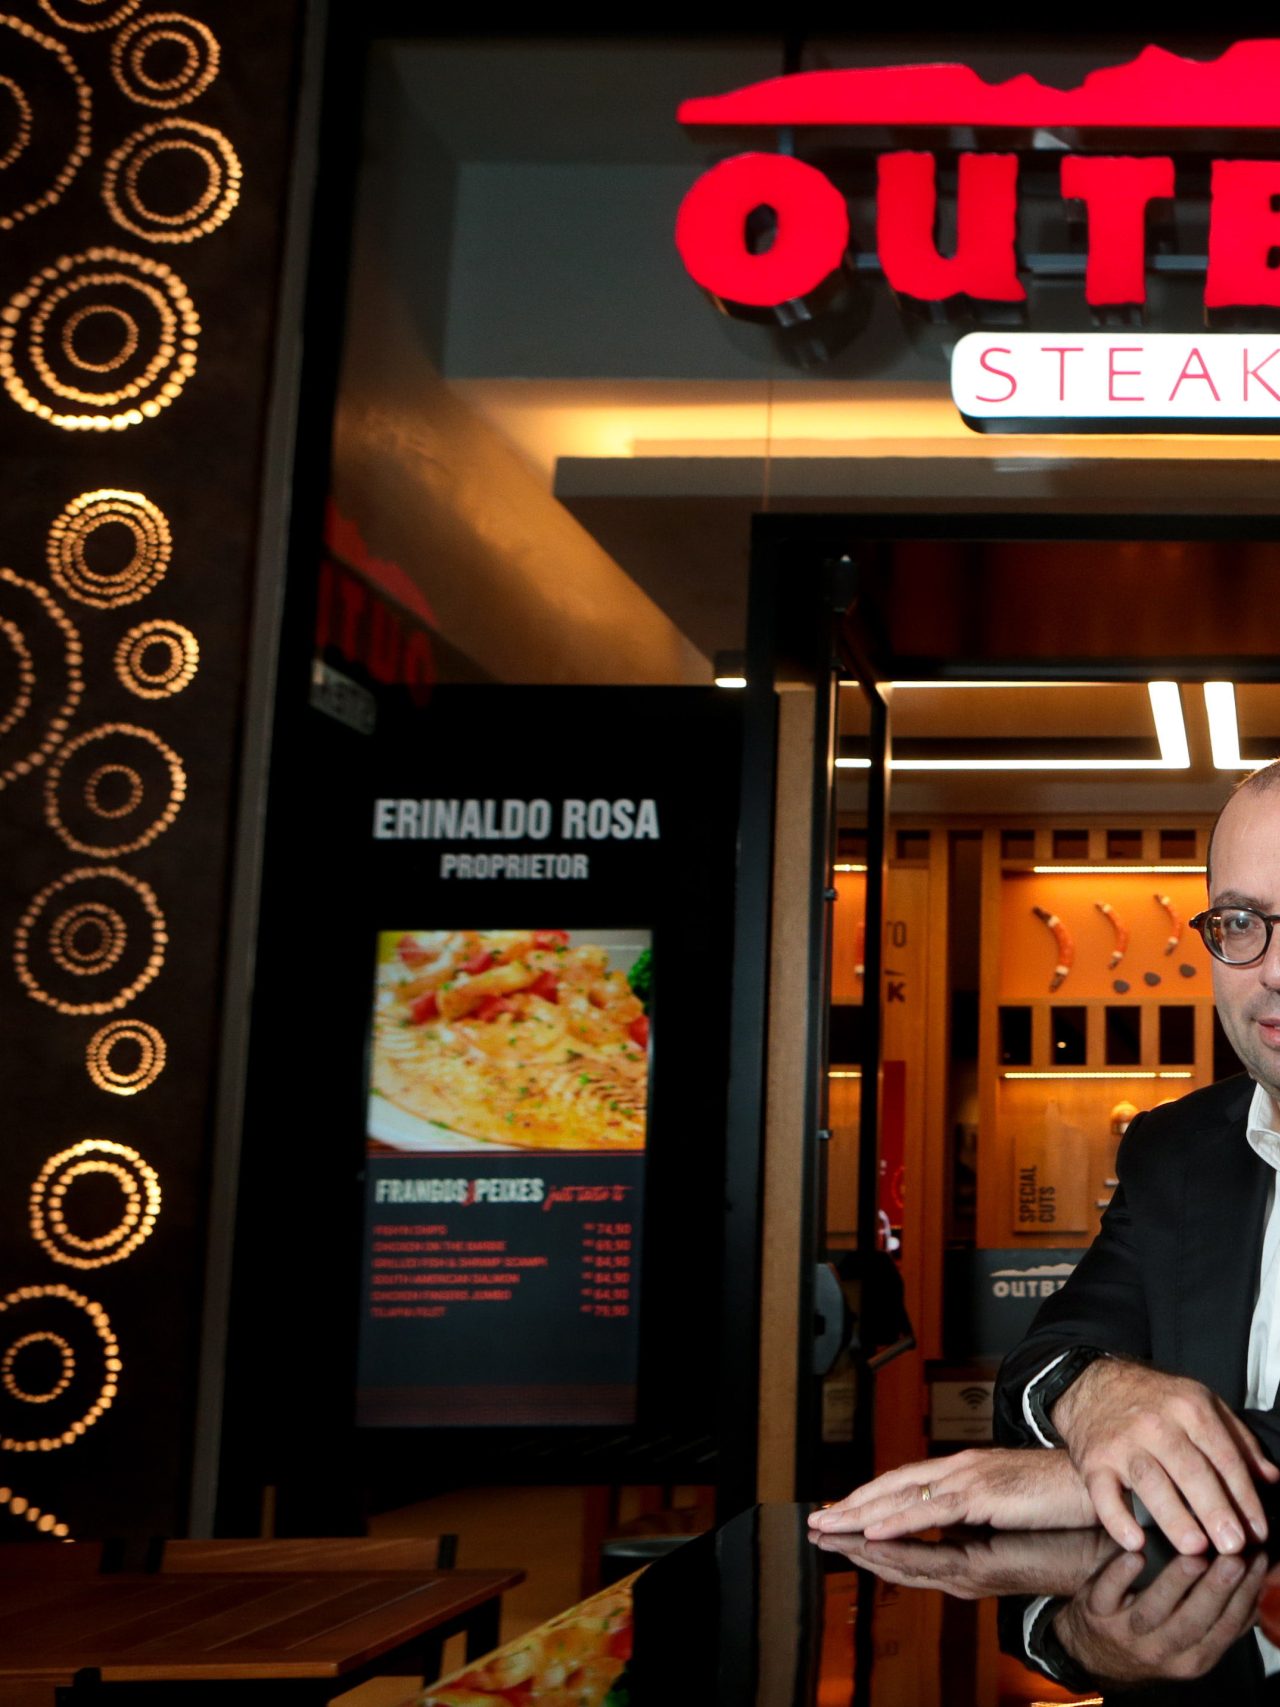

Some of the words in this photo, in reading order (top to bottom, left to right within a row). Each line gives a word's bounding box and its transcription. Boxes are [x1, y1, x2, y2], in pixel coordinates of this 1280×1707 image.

[372, 798, 552, 840] ERINALDO
[560, 798, 661, 840] ROSA
[440, 853, 590, 880] PROPRIETOR
[375, 1178, 469, 1204] FRANGOS
[472, 1178, 544, 1204] PEIXES
[1018, 1165, 1037, 1223] SPECIAL
[1038, 1186, 1055, 1223] CUTS
